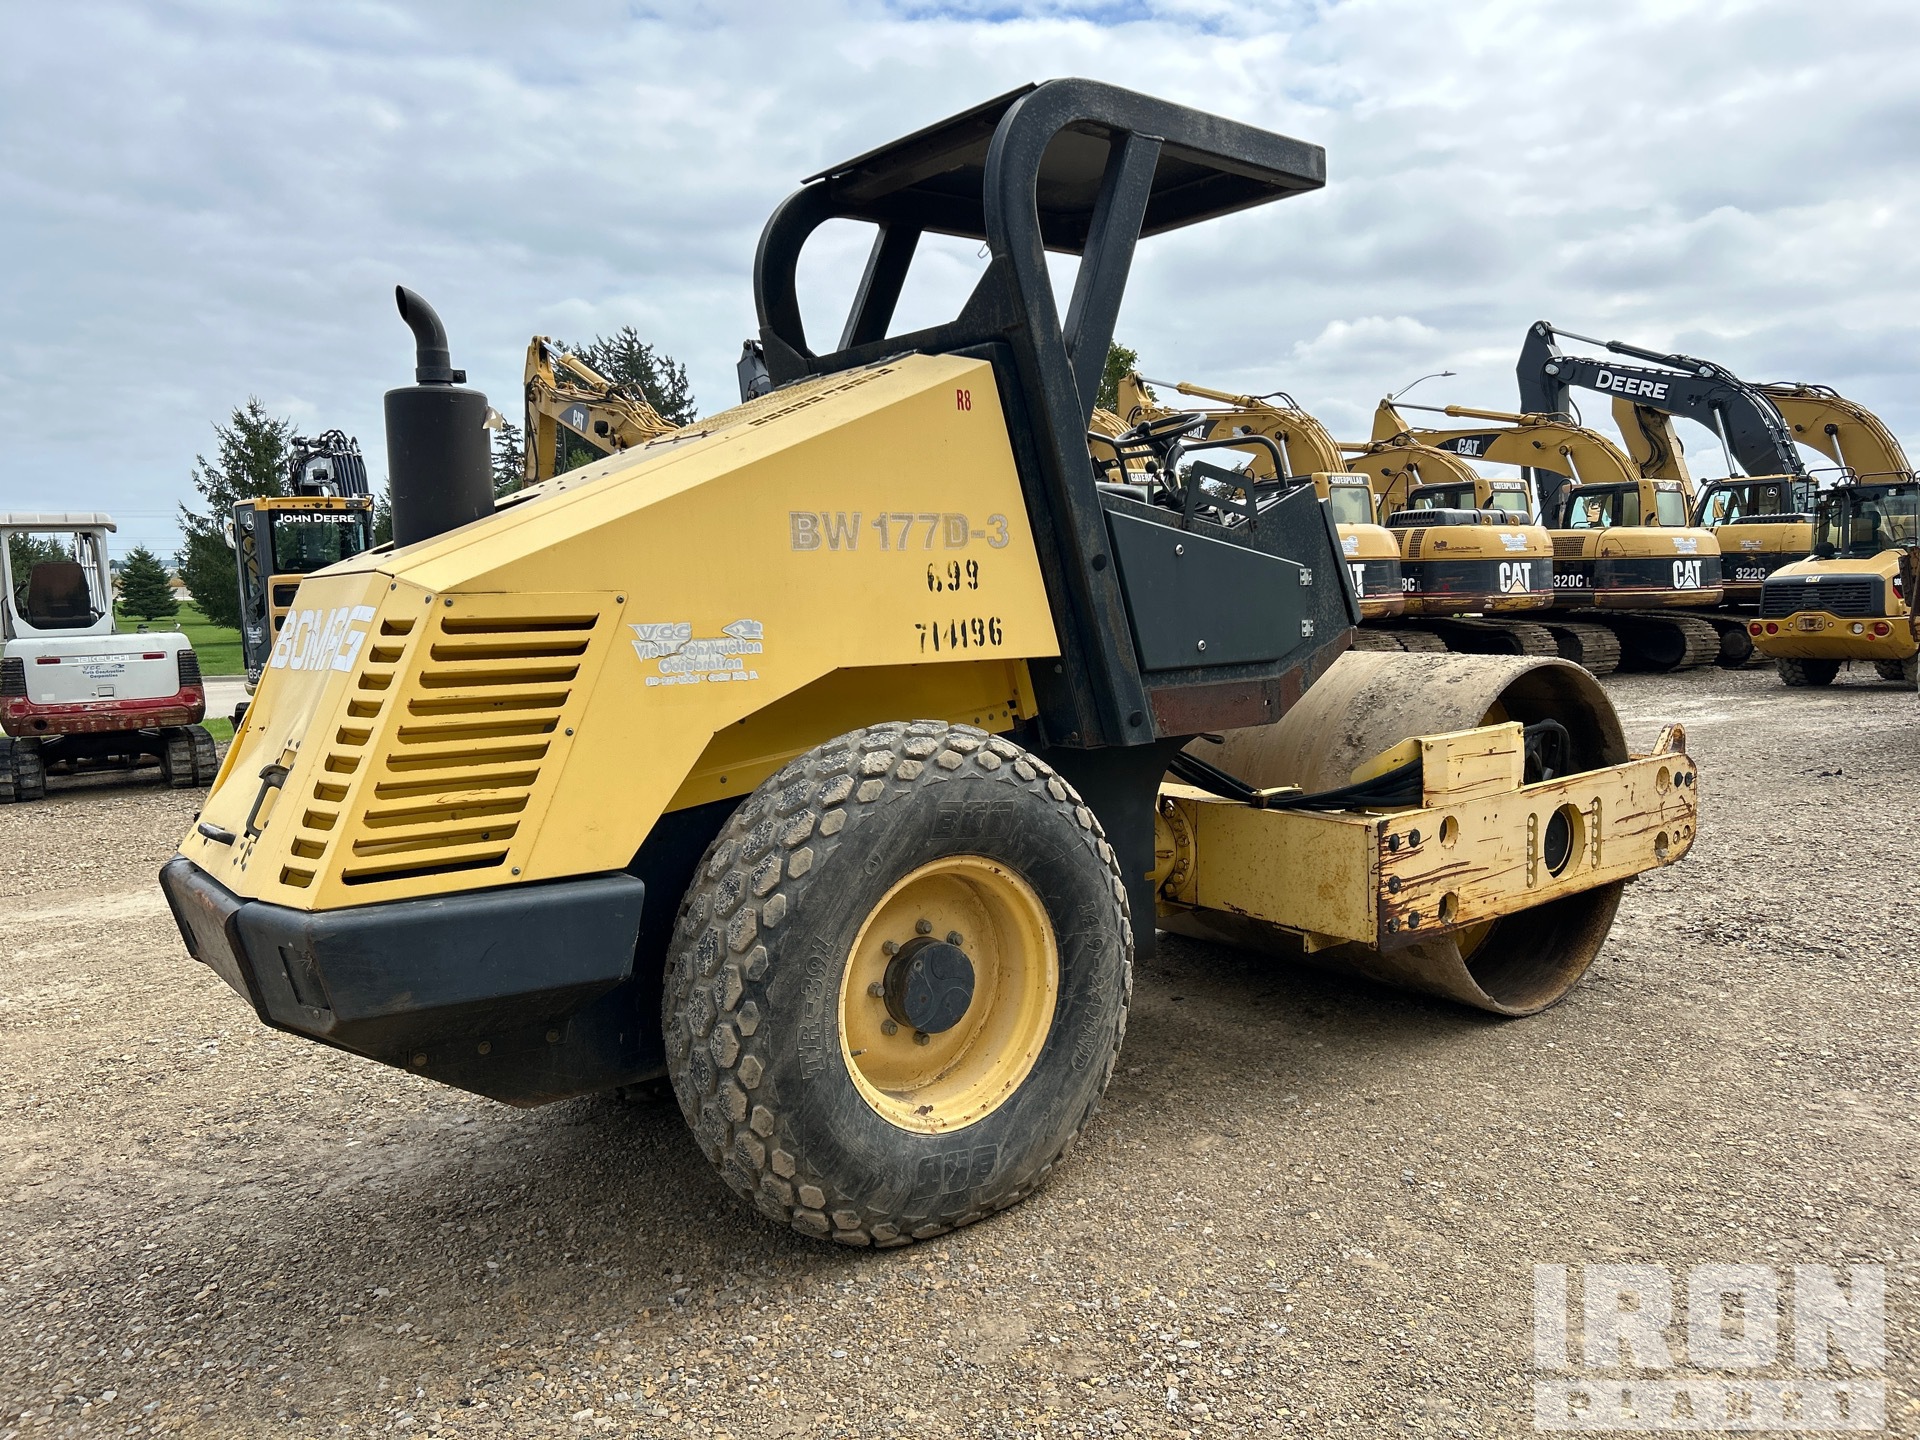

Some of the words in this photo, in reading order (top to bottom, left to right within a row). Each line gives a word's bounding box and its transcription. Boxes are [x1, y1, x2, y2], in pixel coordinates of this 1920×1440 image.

[1595, 370, 1669, 400] DEERE
[956, 389, 971, 411] R8
[1457, 438, 1480, 456] CAT
[1331, 476, 1364, 485] CATERPILLAR
[1493, 481, 1521, 490] CATERPILLAR
[277, 513, 311, 523] JOHN
[313, 513, 356, 523] DEERE
[789, 511, 862, 551] BW
[871, 512, 1010, 551] 177D-3
[927, 559, 979, 592] 699
[1499, 562, 1532, 593] CAT
[1553, 574, 1583, 588] 320C
[1672, 560, 1703, 590] CAT
[1735, 567, 1766, 580] 322C
[1805, 575, 1824, 583] CAT
[270, 605, 377, 673] BOMAG
[630, 623, 691, 640] VCC
[914, 616, 1003, 654] 714196
